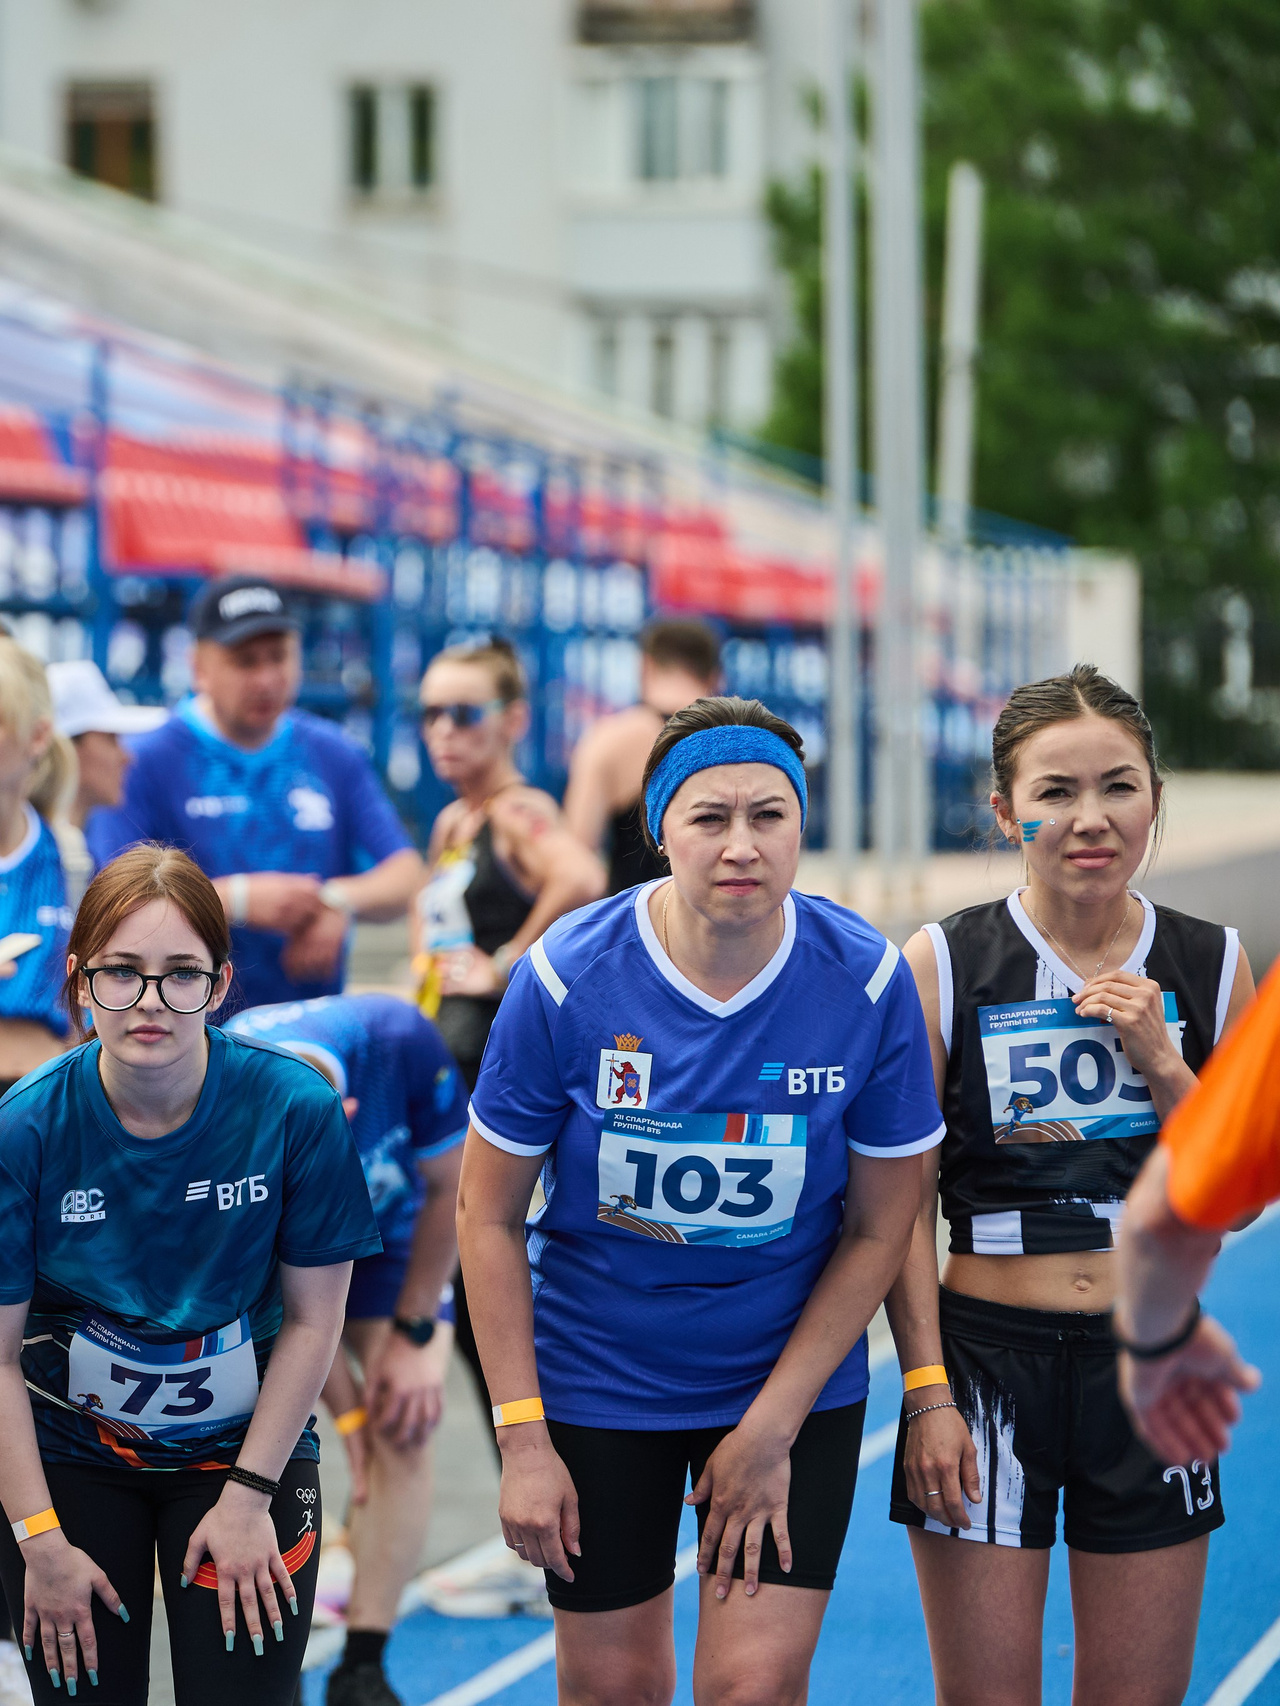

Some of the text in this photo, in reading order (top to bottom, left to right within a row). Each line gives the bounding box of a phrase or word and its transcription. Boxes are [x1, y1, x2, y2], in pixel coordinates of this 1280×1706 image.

[989, 1017, 1039, 1029] ГРУППЫ ВТБ
[999, 1008, 1058, 1020] СПАРТАКИАДА
[788, 1065, 846, 1095] ВТБ
[613, 1121, 661, 1135] ГРУППЫ ВТБ
[625, 1115, 683, 1129] СПАРТАКИАДА
[216, 1174, 269, 1211] ВТБ
[625, 1149, 774, 1218] 103
[60, 1187, 105, 1214] ABC
[736, 1231, 769, 1240] САМАРА
[86, 1325, 123, 1351] ГРУППЫ ВТБ
[97, 1322, 141, 1353] СПАРТАКИАДА
[110, 1362, 214, 1416] 73
[1163, 1459, 1214, 1516] 73
